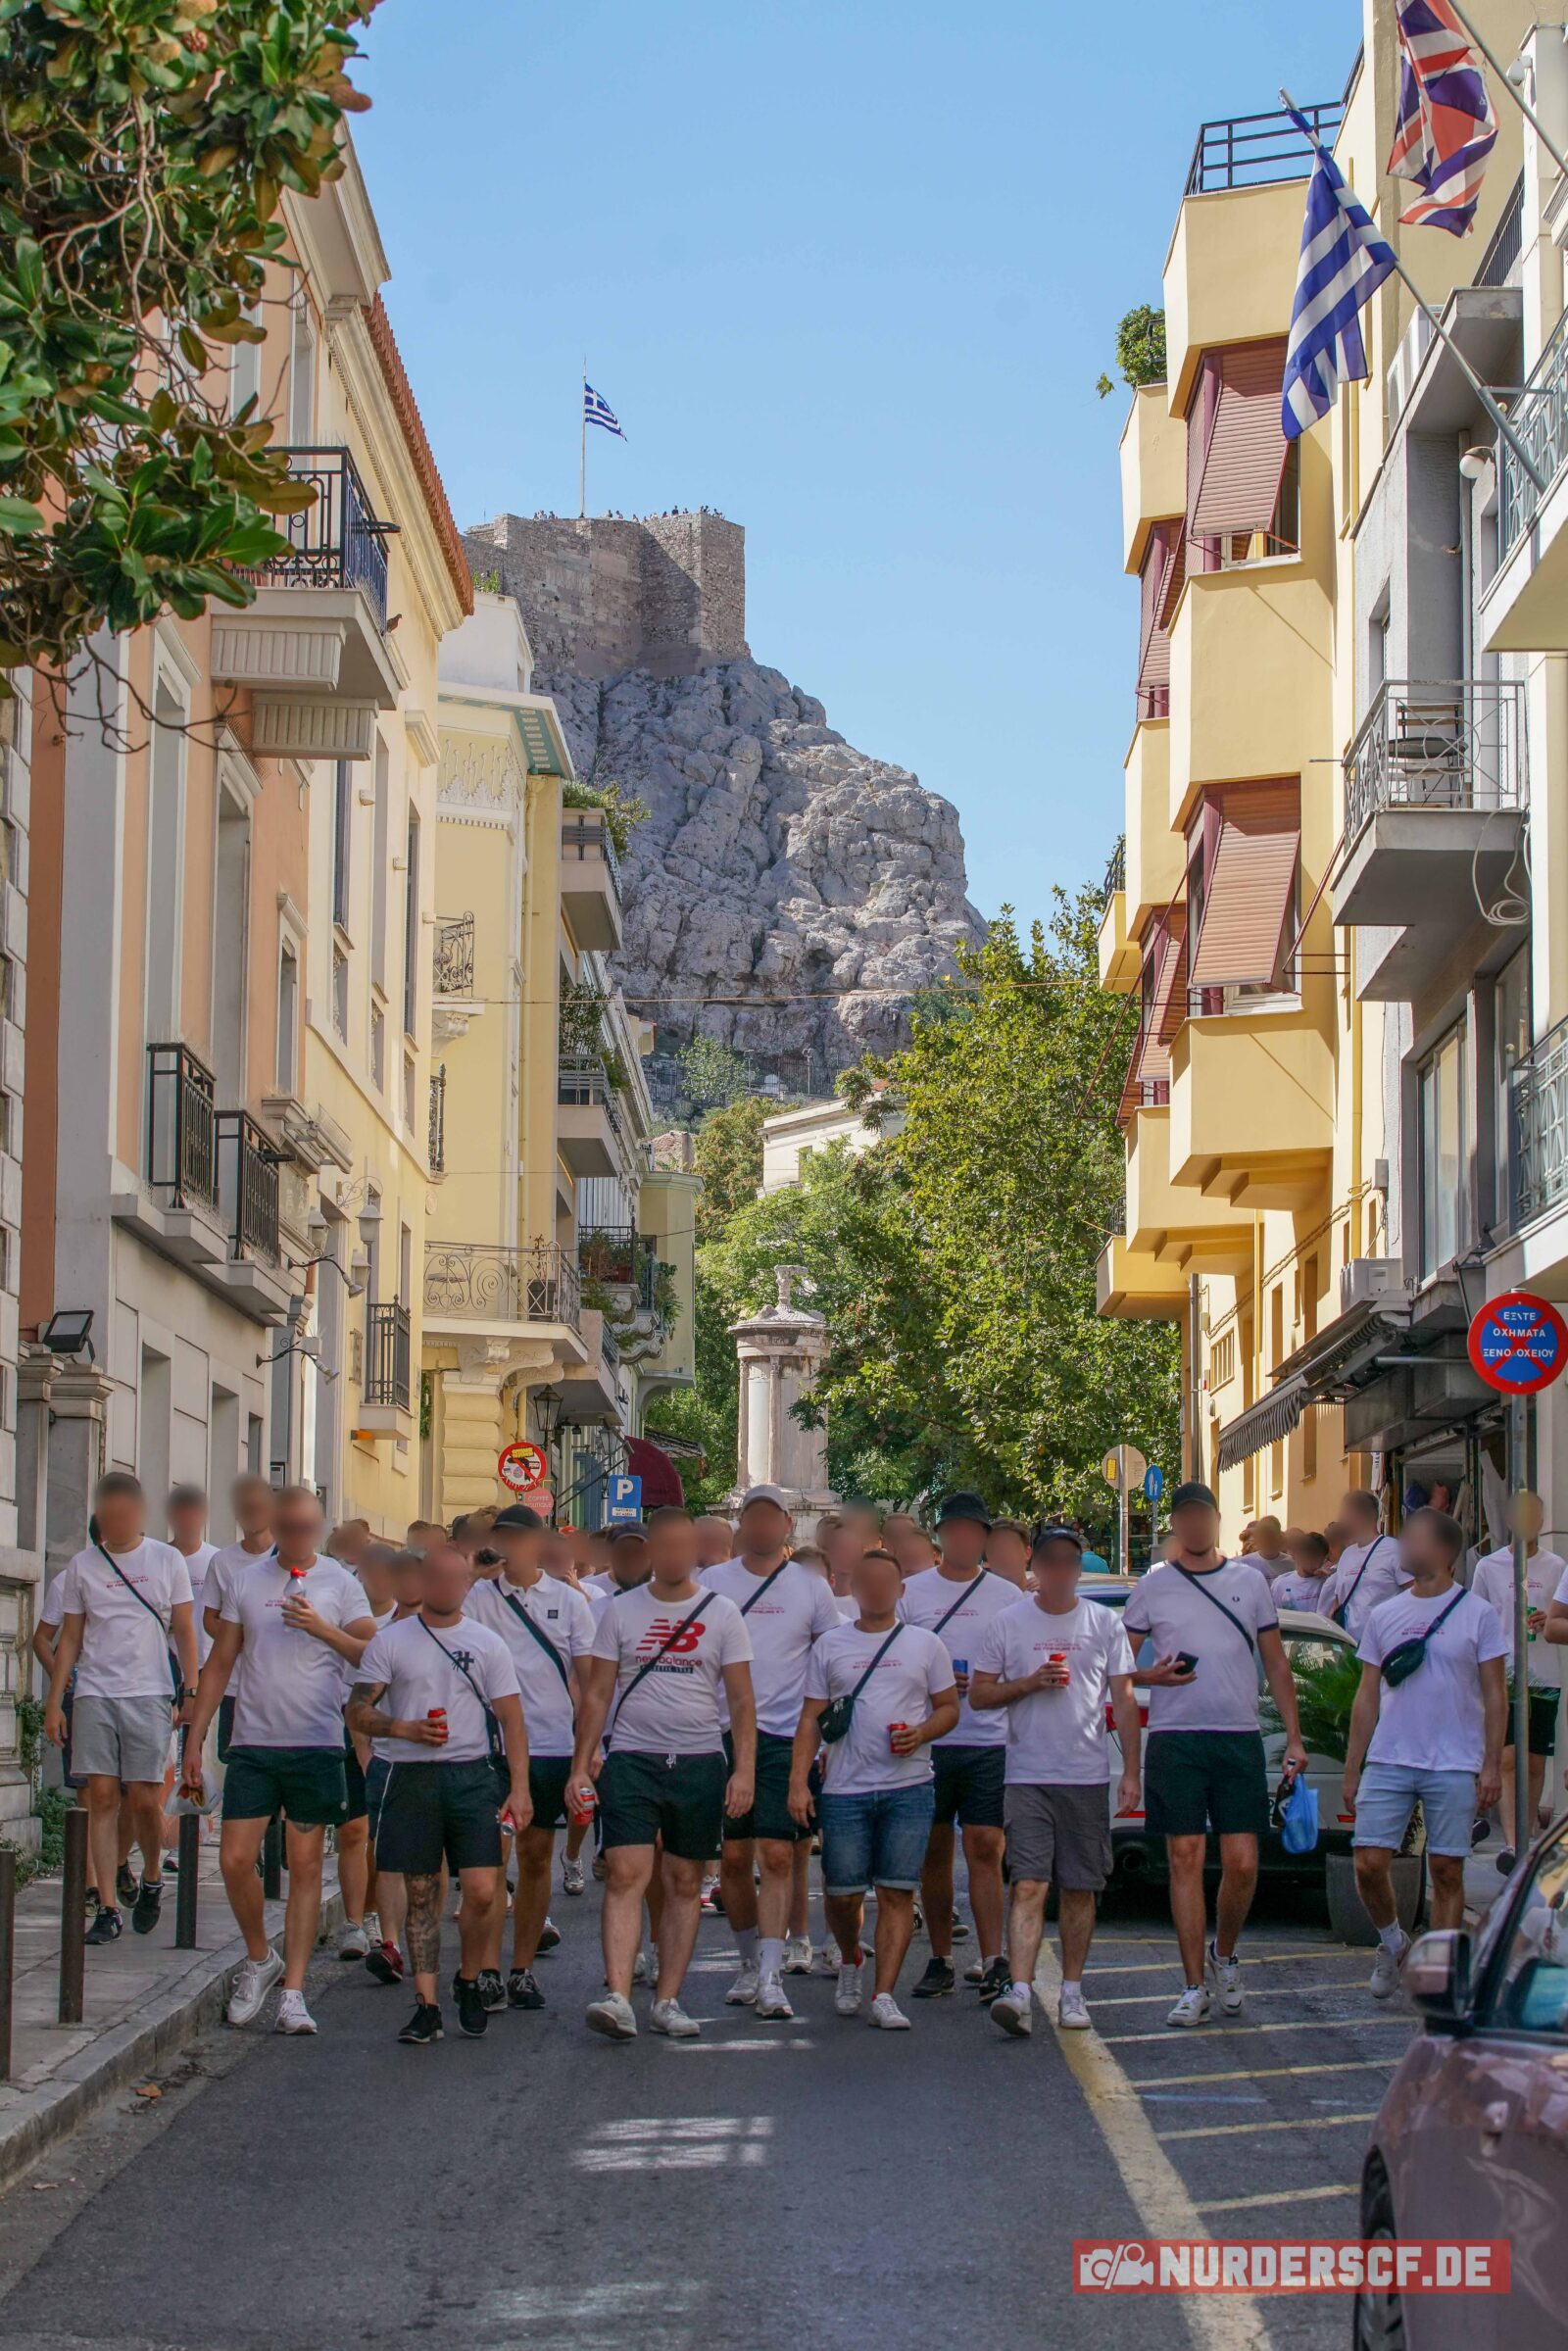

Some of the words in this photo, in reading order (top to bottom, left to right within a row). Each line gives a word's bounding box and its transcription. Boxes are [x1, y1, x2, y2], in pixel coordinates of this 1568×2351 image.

[1493, 1327, 1546, 1338] ΟΧΗΜΑΤΑ
[1483, 1347, 1554, 1358] ΞΕΝΟΟΧΕΙΟΥ
[616, 1479, 633, 1500] P
[658, 1655, 703, 1666] balance
